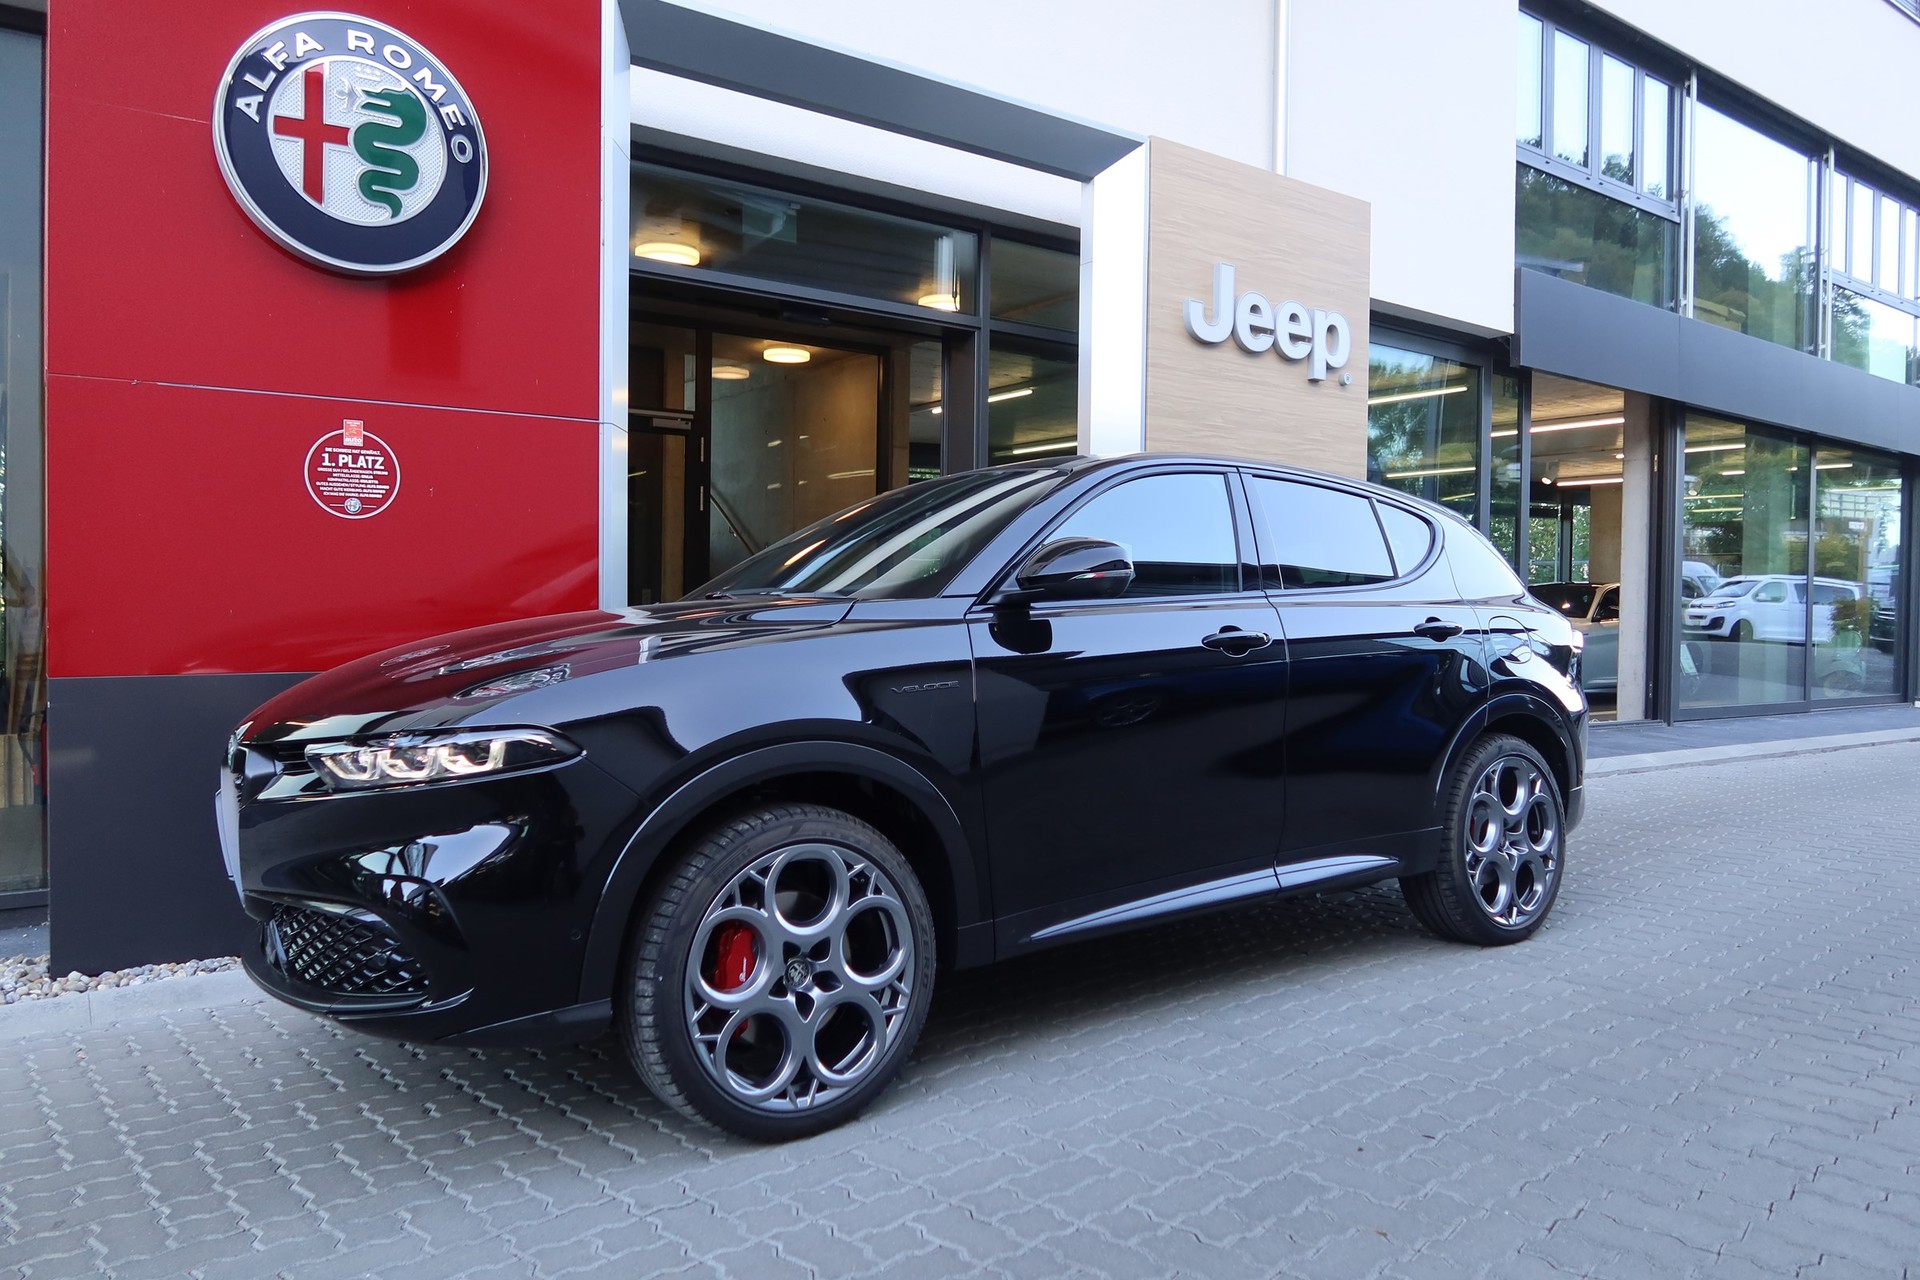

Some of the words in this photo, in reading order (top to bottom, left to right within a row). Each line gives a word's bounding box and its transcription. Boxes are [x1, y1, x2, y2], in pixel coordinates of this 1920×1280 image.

[235, 31, 324, 123] ALFA
[347, 28, 473, 164] ROMEO
[321, 453, 336, 467] 1.
[338, 454, 385, 470] PLATZ
